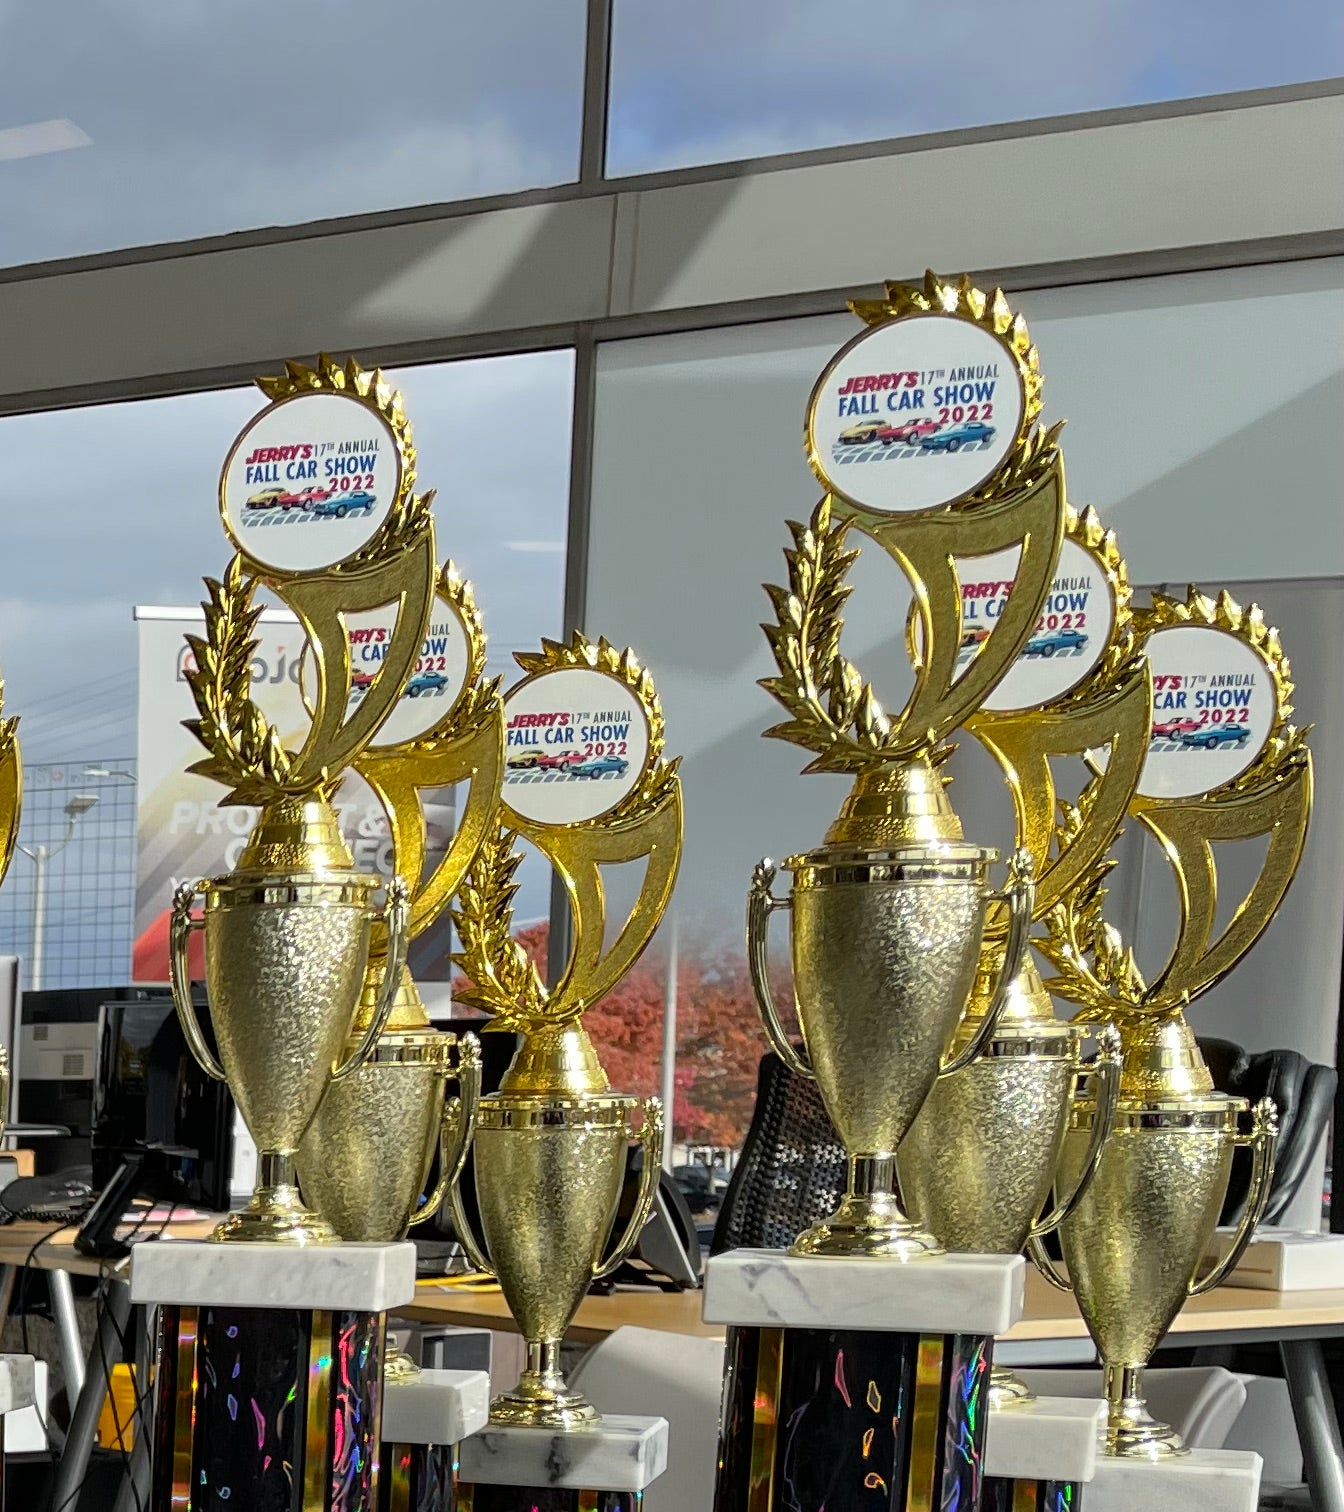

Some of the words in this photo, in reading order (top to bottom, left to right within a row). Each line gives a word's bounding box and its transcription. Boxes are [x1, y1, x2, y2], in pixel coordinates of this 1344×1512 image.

[838, 371, 919, 394] JERRY'S
[921, 369, 945, 386] 17TH
[949, 364, 999, 382] ANNUAL
[839, 393, 879, 417] FALL
[887, 388, 924, 411] CAR
[934, 381, 995, 407] SHOW
[939, 404, 993, 424] 2022
[246, 444, 313, 464] JERRY'S
[314, 442, 334, 458] 17TH
[338, 439, 379, 454] ANNUAL
[246, 465, 279, 485] FALL
[286, 461, 317, 479] CAR
[325, 454, 377, 476] SHOW
[329, 474, 374, 492] 2022
[1053, 576, 1091, 591] NNUAL
[415, 657, 446, 672] 022
[1210, 673, 1256, 687] ANNUAL
[1154, 691, 1187, 709] CAR
[1195, 689, 1252, 708] SHOW
[507, 712, 570, 728] JERRY'S
[572, 712, 590, 724] 17TH
[593, 711, 632, 723] ANNUAL
[1199, 708, 1249, 724] 2022
[508, 729, 538, 745] FALL
[545, 727, 574, 744] CAR
[581, 724, 629, 742] SHOW
[585, 742, 627, 756] 2022
